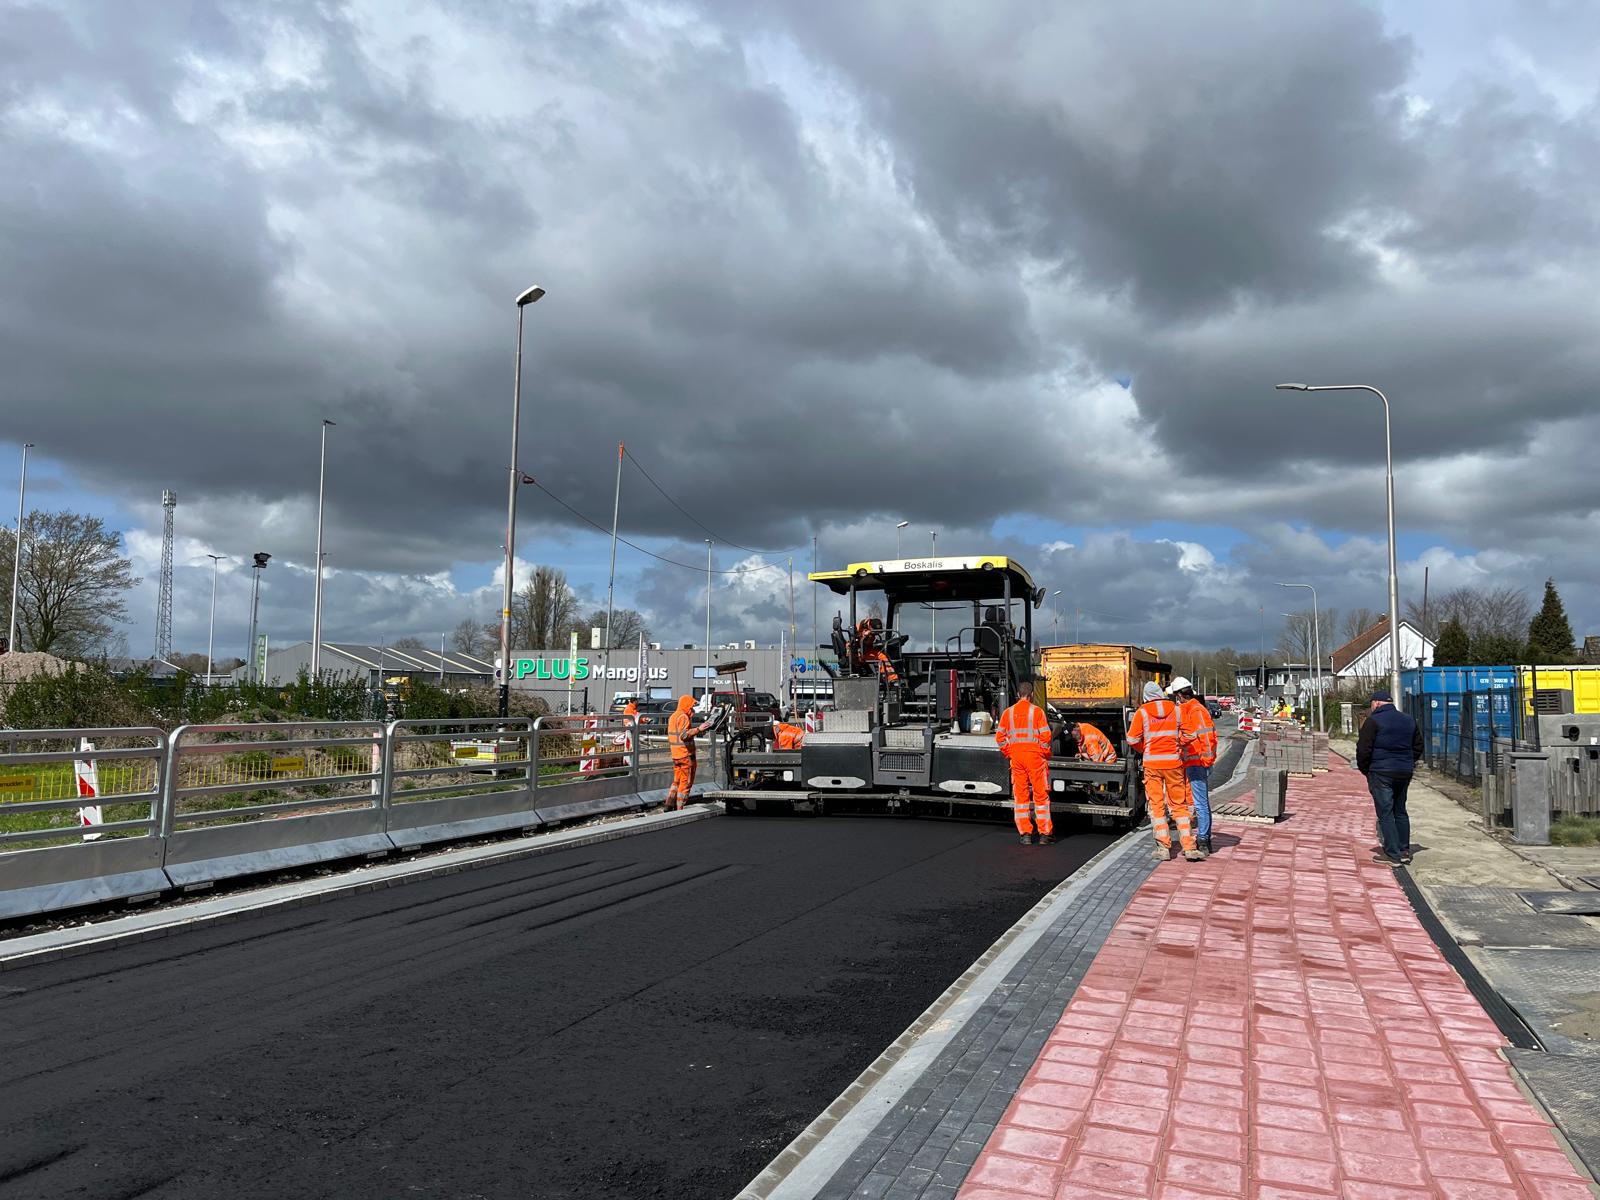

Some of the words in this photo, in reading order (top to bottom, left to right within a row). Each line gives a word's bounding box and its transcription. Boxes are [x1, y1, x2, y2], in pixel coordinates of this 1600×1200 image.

[904, 561, 943, 570] Boskalis
[517, 658, 589, 679] PLUS
[592, 664, 668, 682] Mangus
